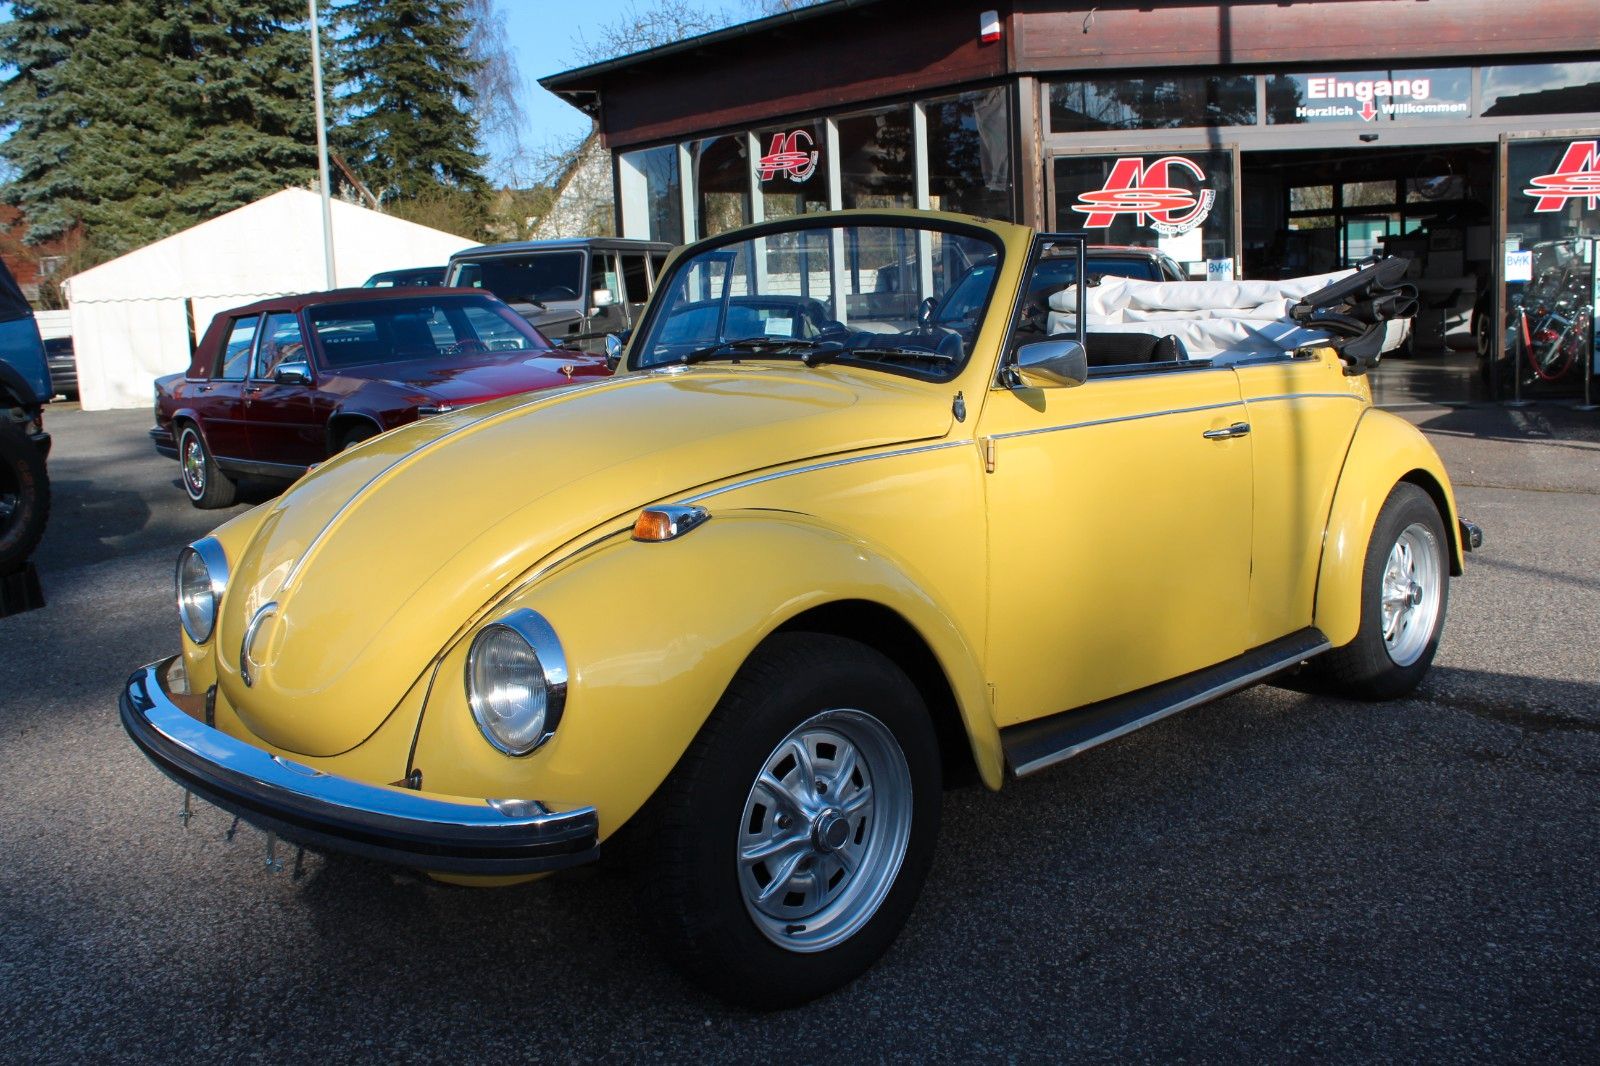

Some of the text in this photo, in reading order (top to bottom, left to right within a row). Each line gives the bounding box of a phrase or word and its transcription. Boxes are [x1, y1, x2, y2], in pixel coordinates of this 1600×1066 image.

[1307, 77, 1431, 102] Eingang
[1296, 102, 1467, 118] Herzlich Willkommen
